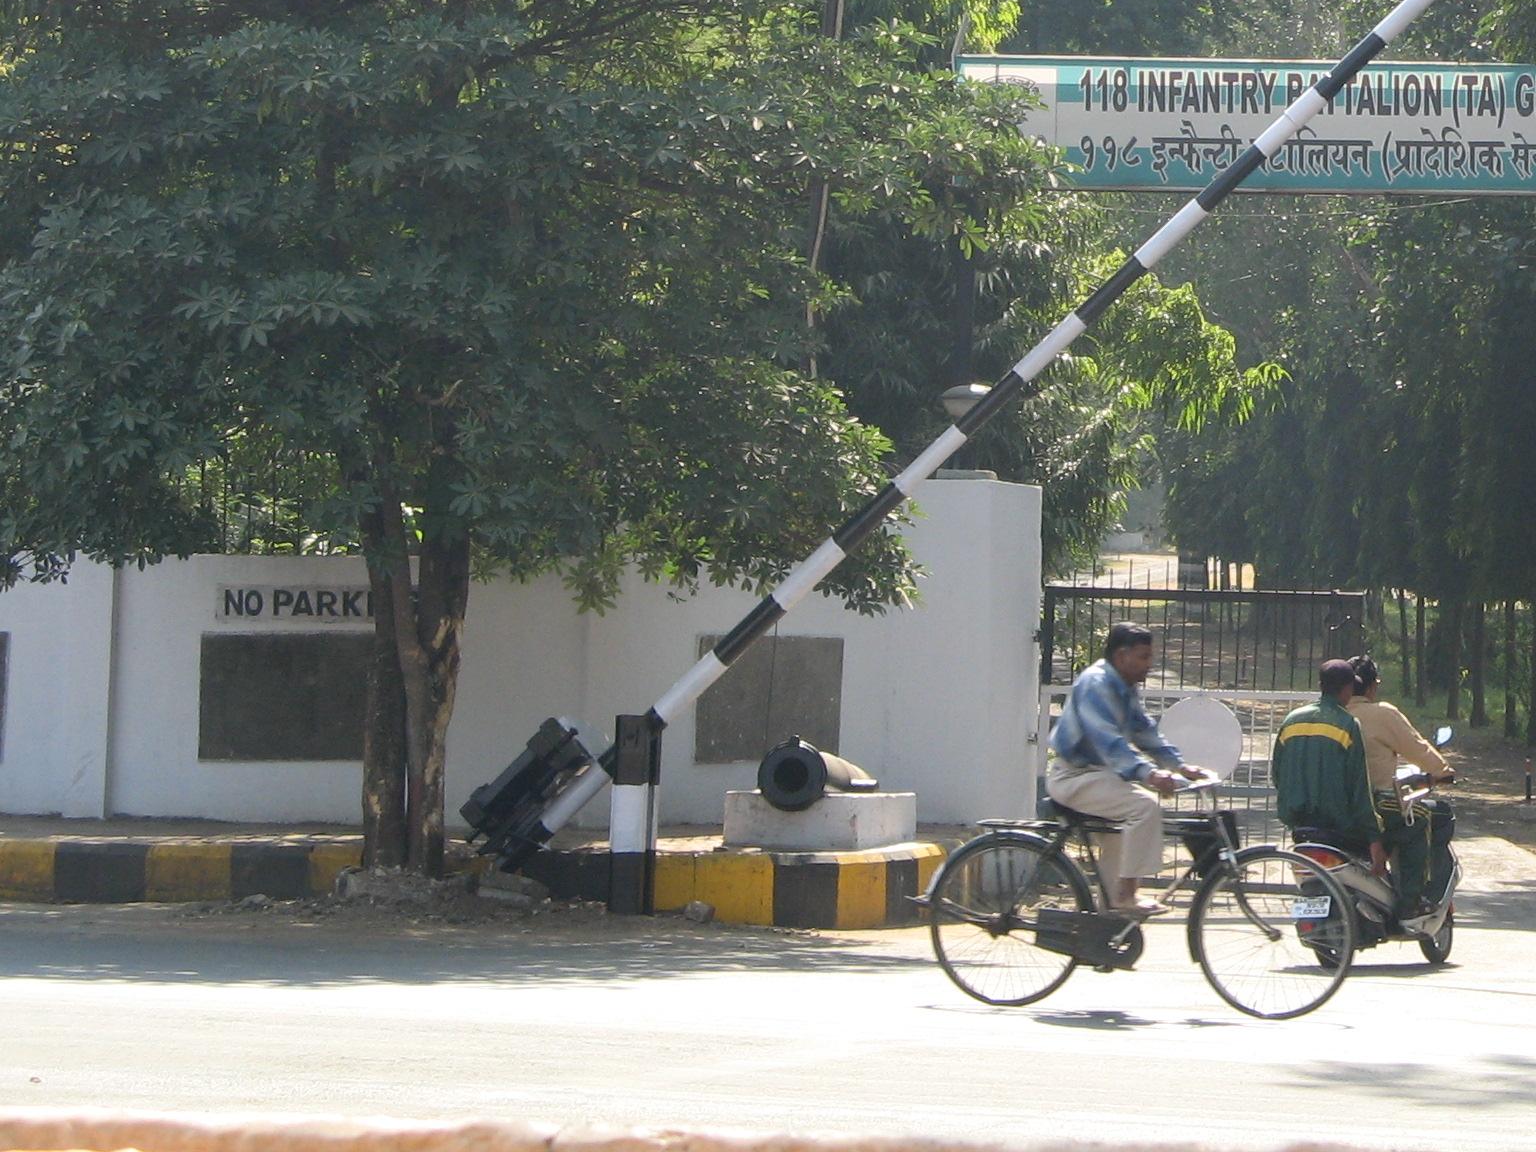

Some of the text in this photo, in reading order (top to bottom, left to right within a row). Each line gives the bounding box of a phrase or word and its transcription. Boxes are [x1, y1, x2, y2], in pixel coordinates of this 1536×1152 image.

[1080, 69, 1129, 113] 118
[1137, 70, 1278, 115] INFANTRY
[1286, 72, 1443, 118] BTALION
[1452, 72, 1506, 128] (TA)
[1250, 125, 1374, 176] टालियन
[224, 589, 264, 617] NO
